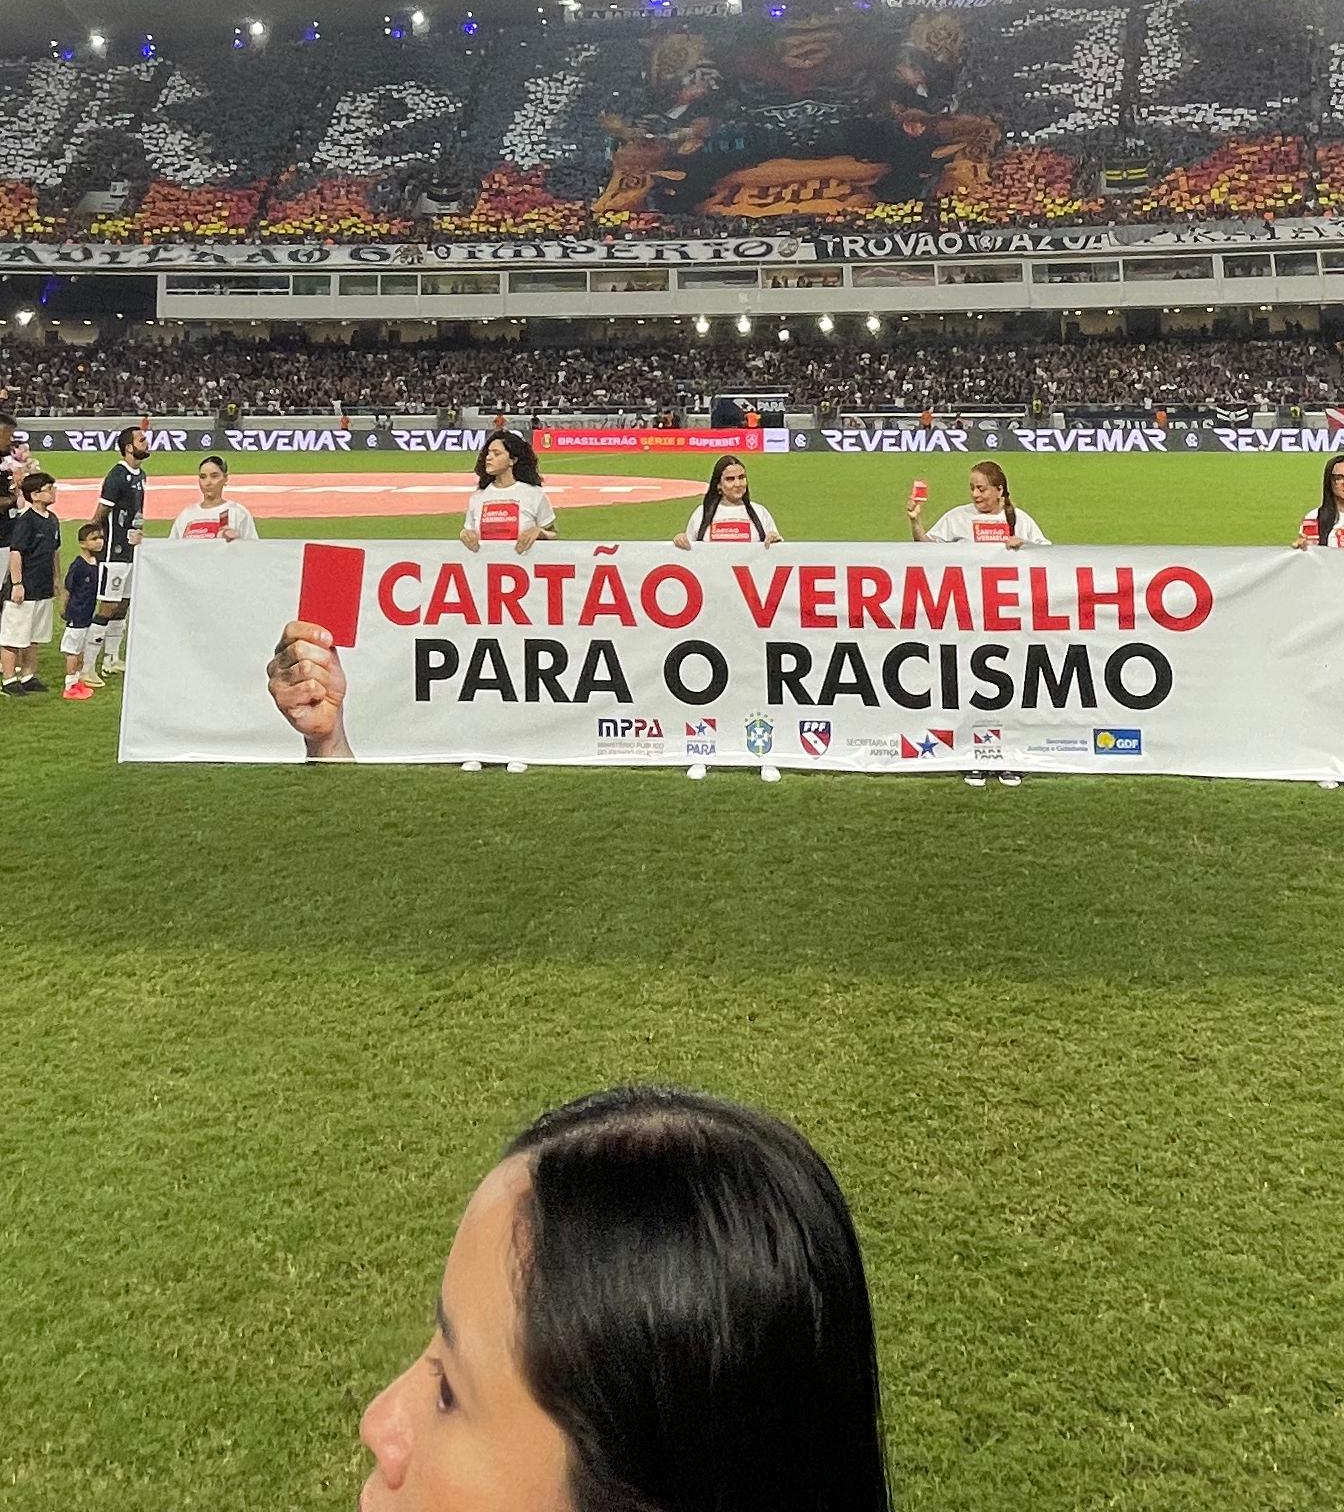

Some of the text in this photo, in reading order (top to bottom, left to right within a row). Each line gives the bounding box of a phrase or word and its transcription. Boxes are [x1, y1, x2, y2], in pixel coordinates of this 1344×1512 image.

[224, 430, 352, 451] REVEMAR
[557, 434, 637, 446] BRASILEIRÃO
[688, 436, 741, 448] SUPERBET
[821, 429, 970, 452] REVEMAR
[1014, 429, 1168, 452] REVEMAR
[378, 545, 1213, 632] CARTÃO VERMELHO
[414, 638, 1173, 710] PARA O RACISMO
[598, 719, 665, 738] MPPA
[803, 721, 825, 732] FPF
[870, 749, 899, 759] JUSTIÇA
[1116, 738, 1140, 750] GDF
